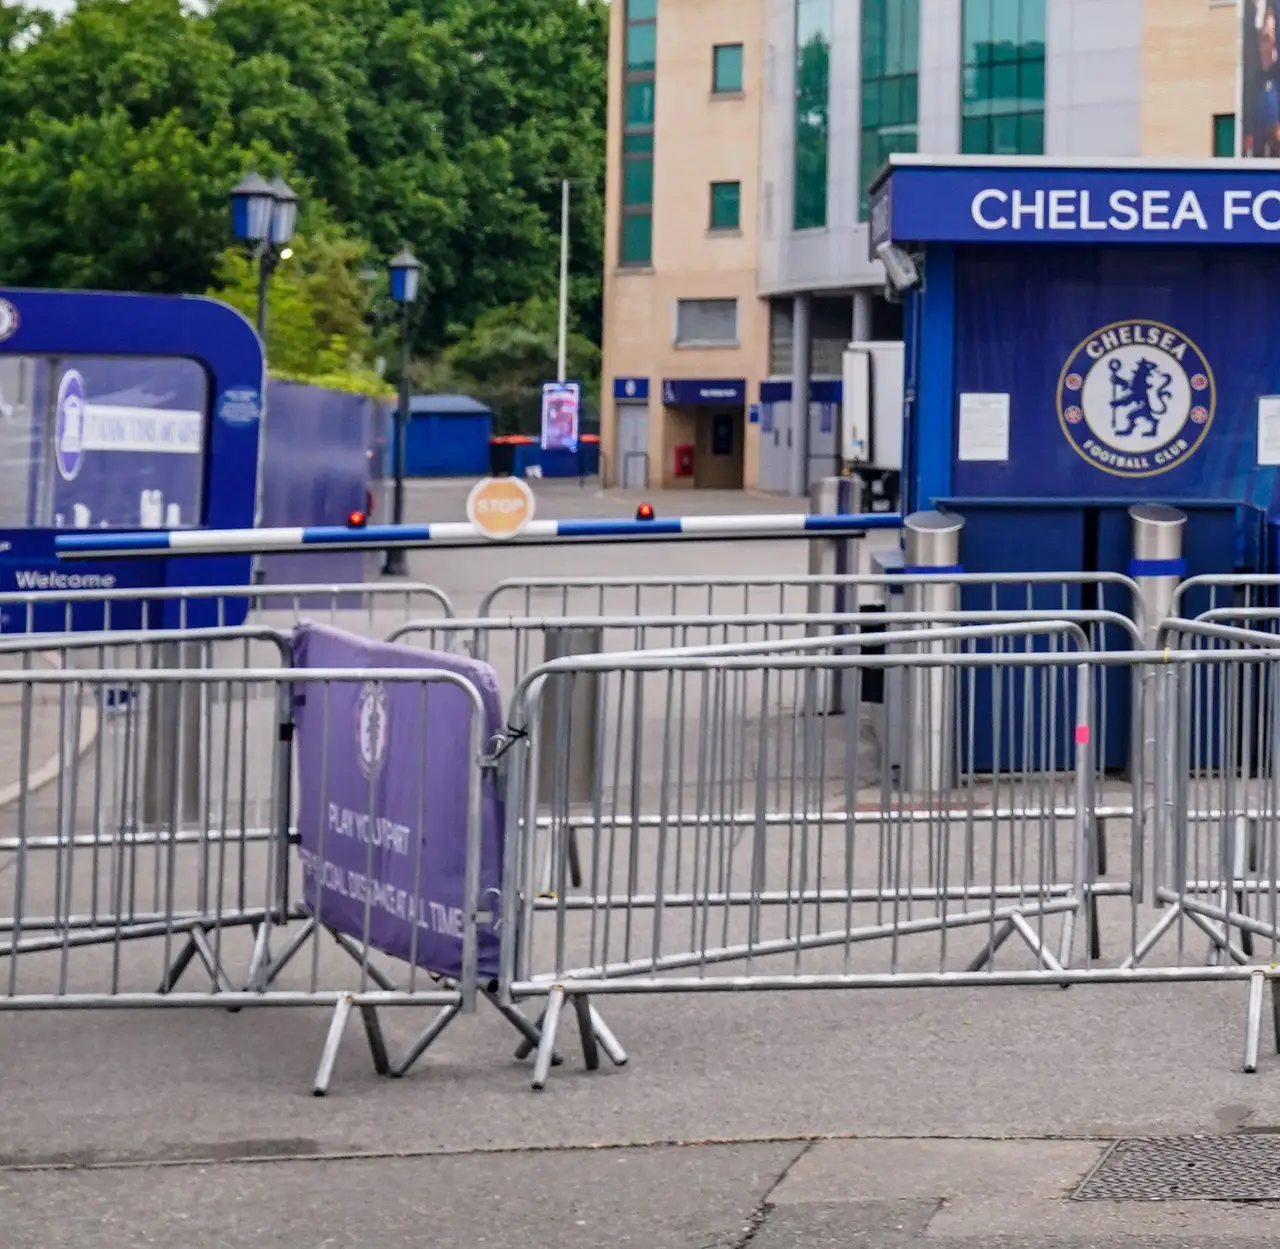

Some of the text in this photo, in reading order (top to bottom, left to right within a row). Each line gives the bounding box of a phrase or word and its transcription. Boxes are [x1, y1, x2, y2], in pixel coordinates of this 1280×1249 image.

[971, 189, 1208, 230] CHELSEA
[1086, 325, 1187, 361] CHELSEA
[1083, 438, 1188, 469] FOOTBALL CLUB
[476, 498, 525, 514] STOP
[16, 570, 117, 590] Welcome
